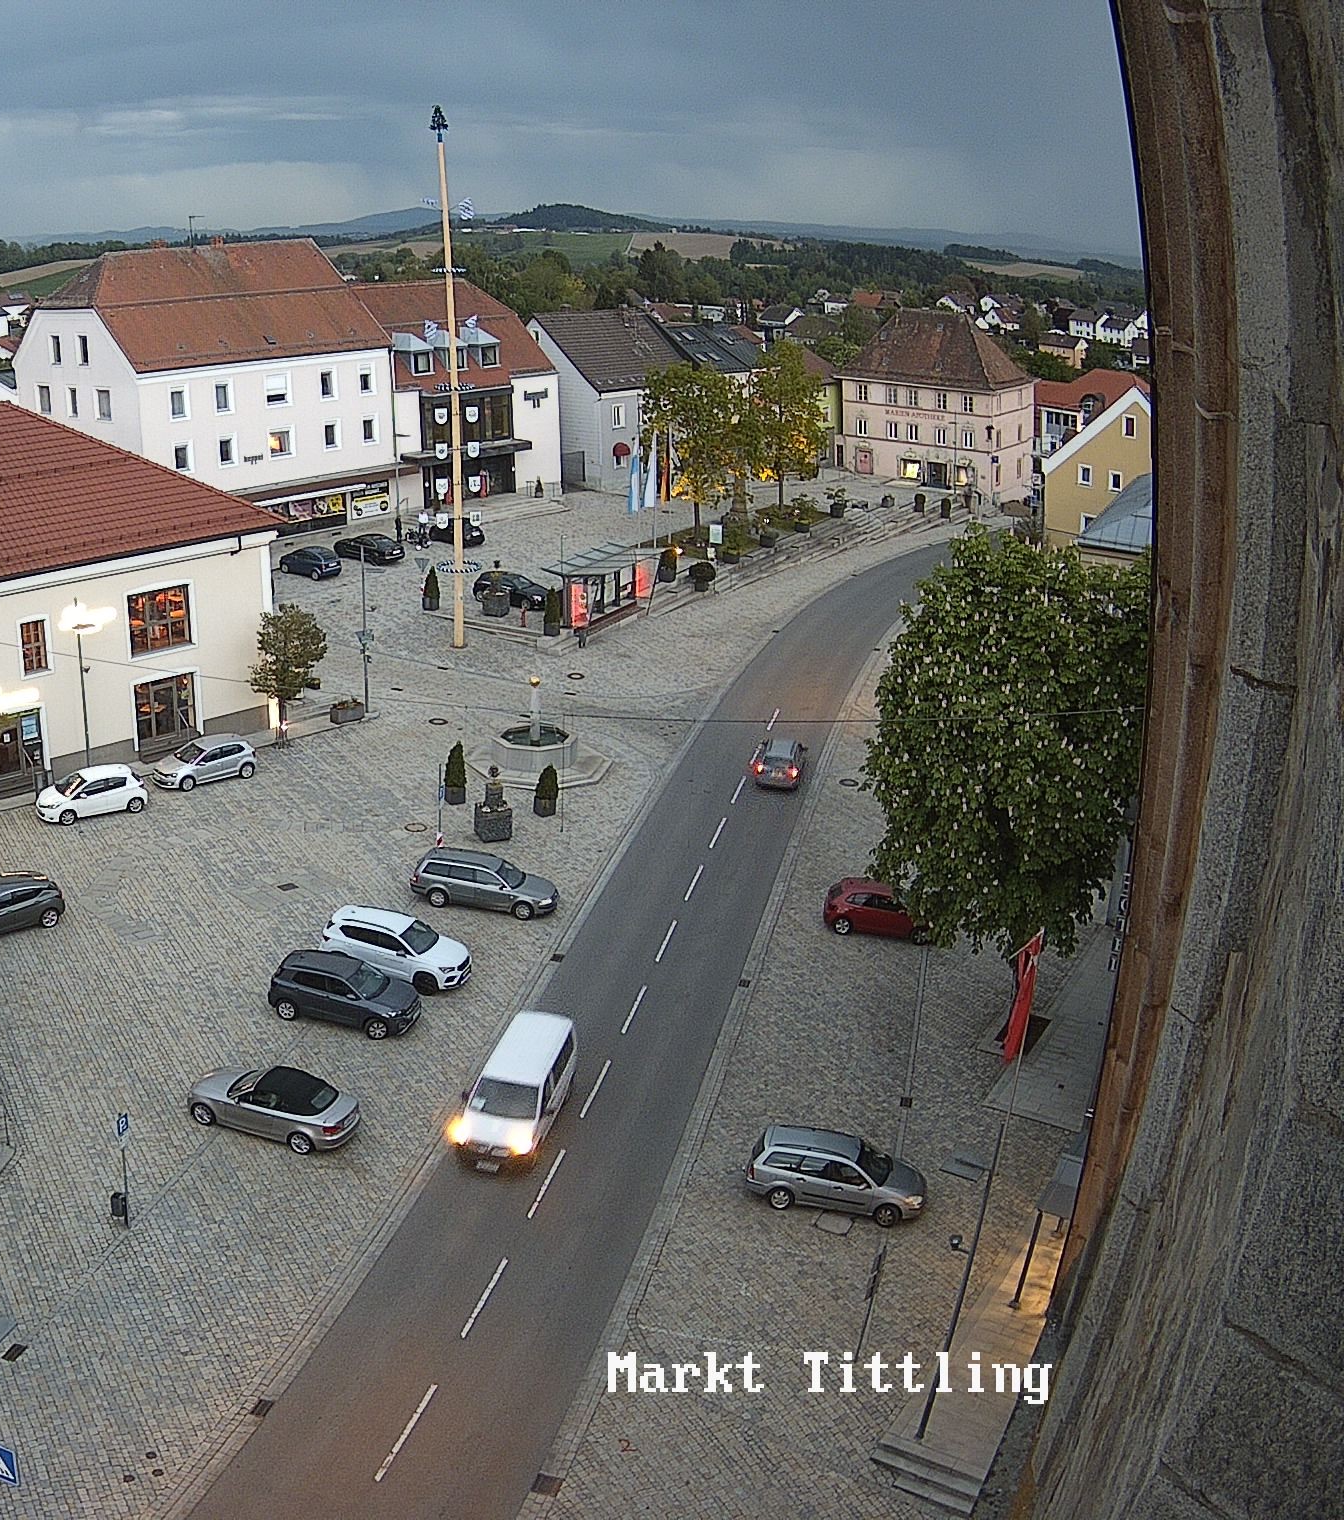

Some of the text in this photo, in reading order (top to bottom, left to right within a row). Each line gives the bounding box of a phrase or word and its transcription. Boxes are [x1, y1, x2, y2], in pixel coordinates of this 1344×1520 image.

[884, 408, 946, 421] MARIEN APOTHEKE
[119, 1116, 127, 1134] P
